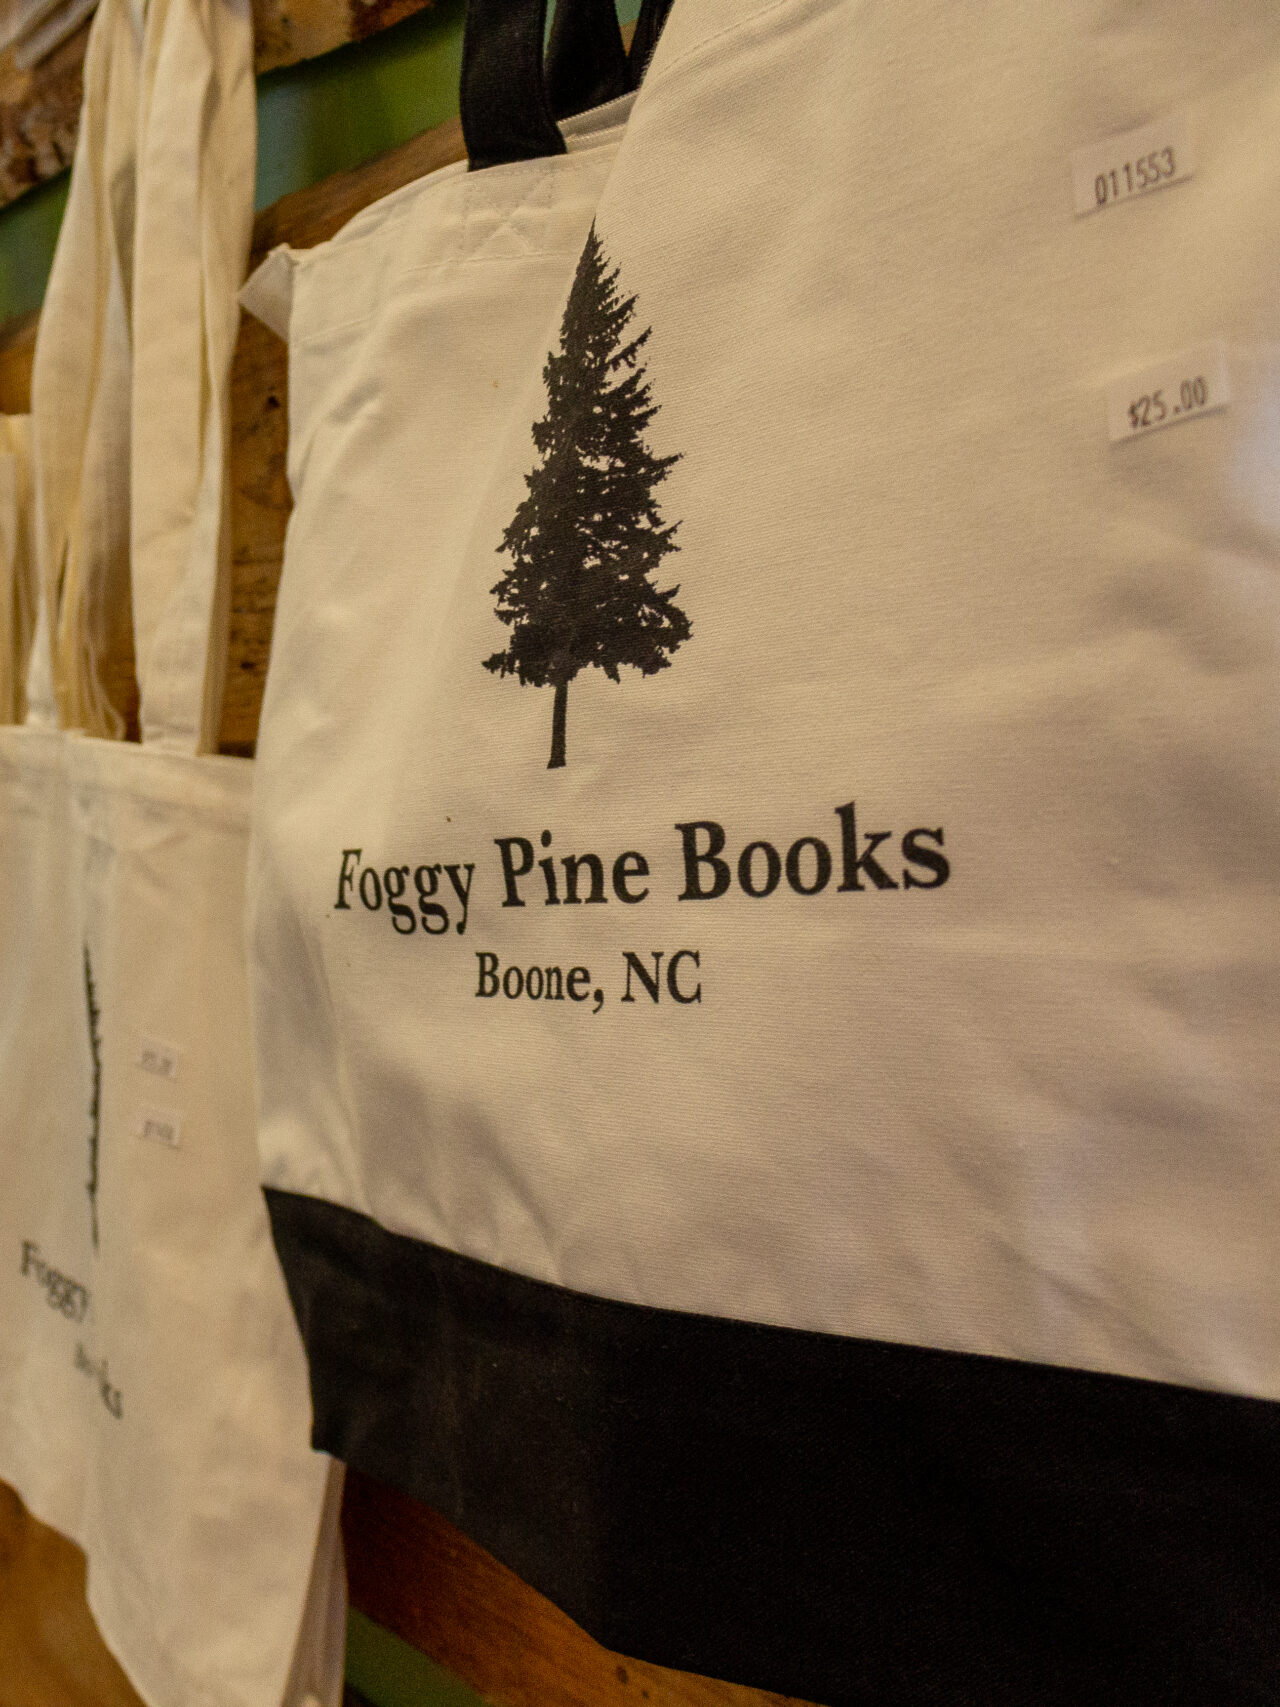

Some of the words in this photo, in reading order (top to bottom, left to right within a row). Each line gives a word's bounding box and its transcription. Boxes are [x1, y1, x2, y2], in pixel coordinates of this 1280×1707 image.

[1094, 146, 1176, 206] 011553
[1128, 376, 1208, 428] $25.00
[334, 849, 475, 936] Foggy
[494, 829, 650, 908] Pine
[674, 801, 951, 902] Books
[475, 951, 605, 1014] Boone,
[620, 950, 702, 1005] NC
